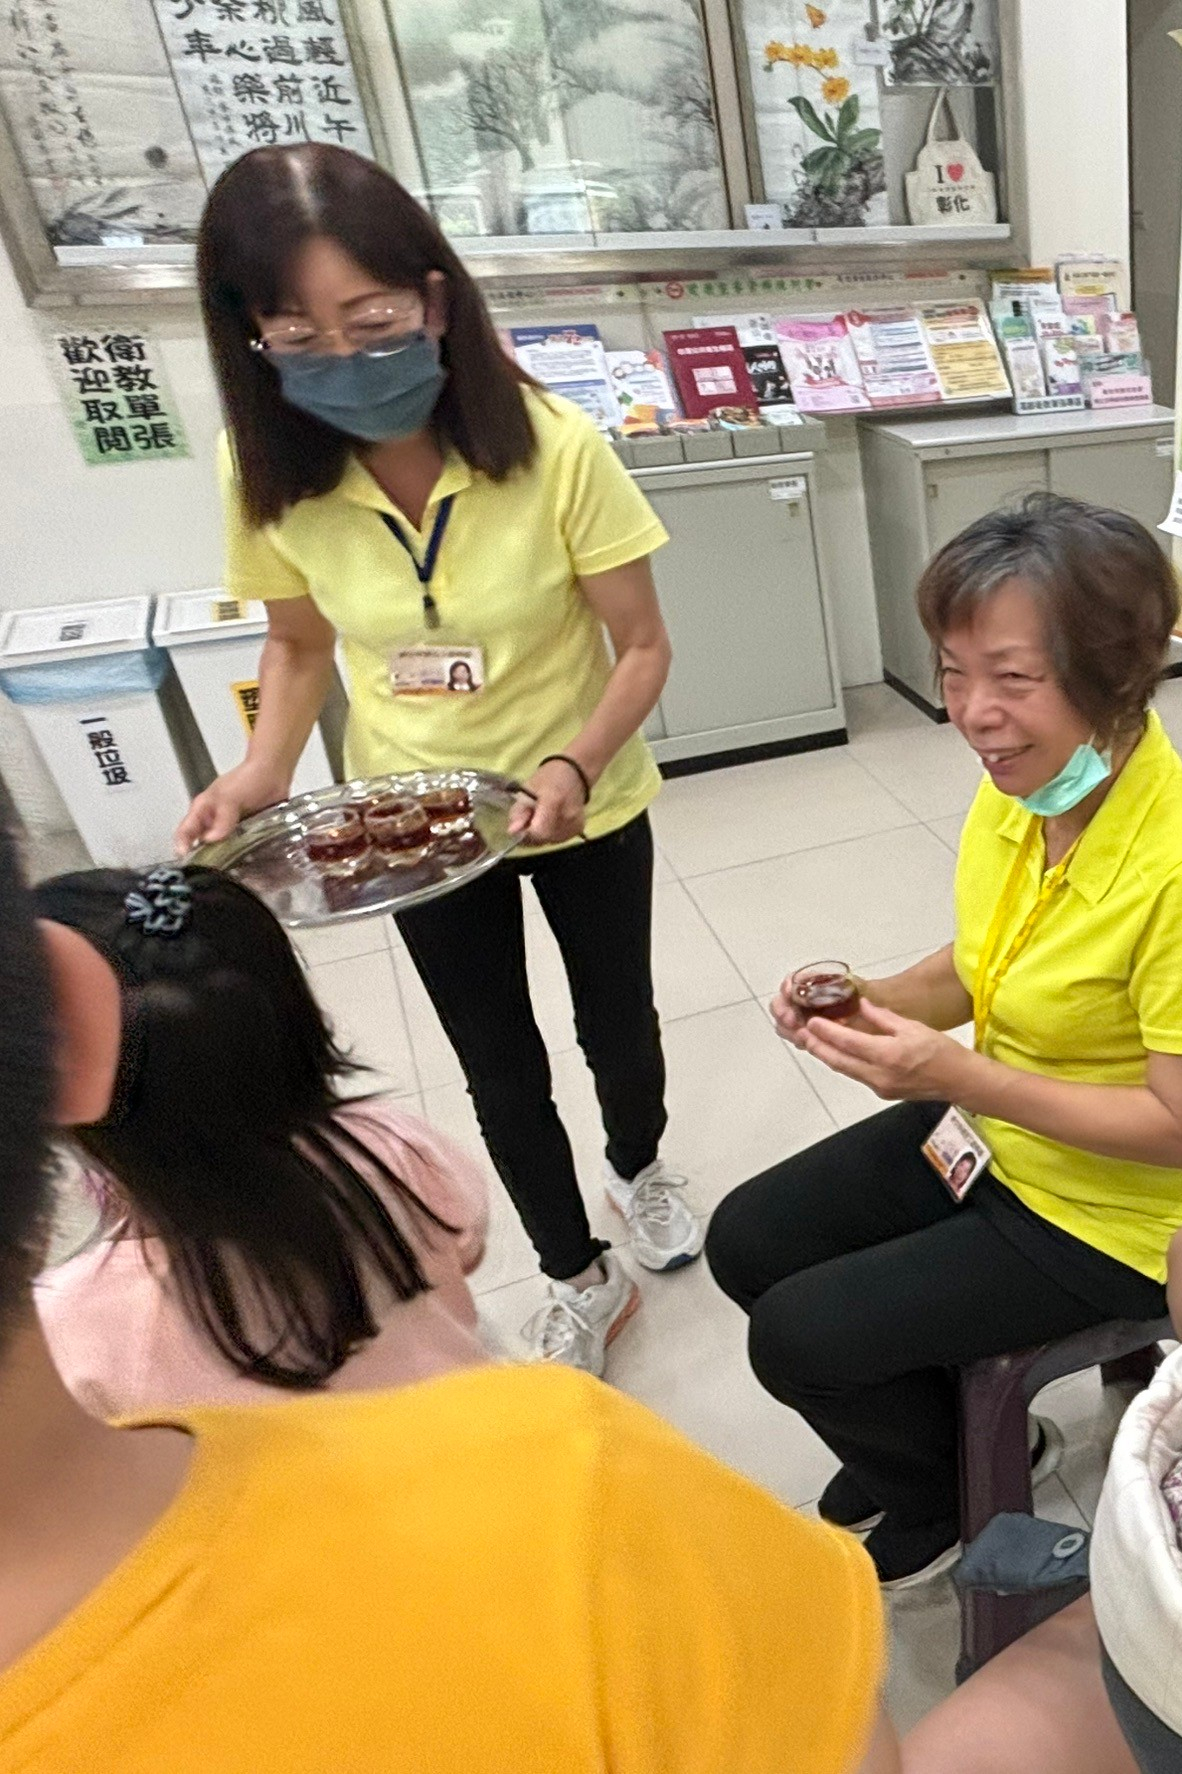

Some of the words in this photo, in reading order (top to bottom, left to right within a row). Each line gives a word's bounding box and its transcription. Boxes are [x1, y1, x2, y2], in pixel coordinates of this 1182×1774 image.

[934, 164, 946, 184] I
[57, 335, 133, 454] 歡迎取閱
[100, 334, 176, 451] 衛教單張
[79, 716, 132, 787] 一般垃圾
